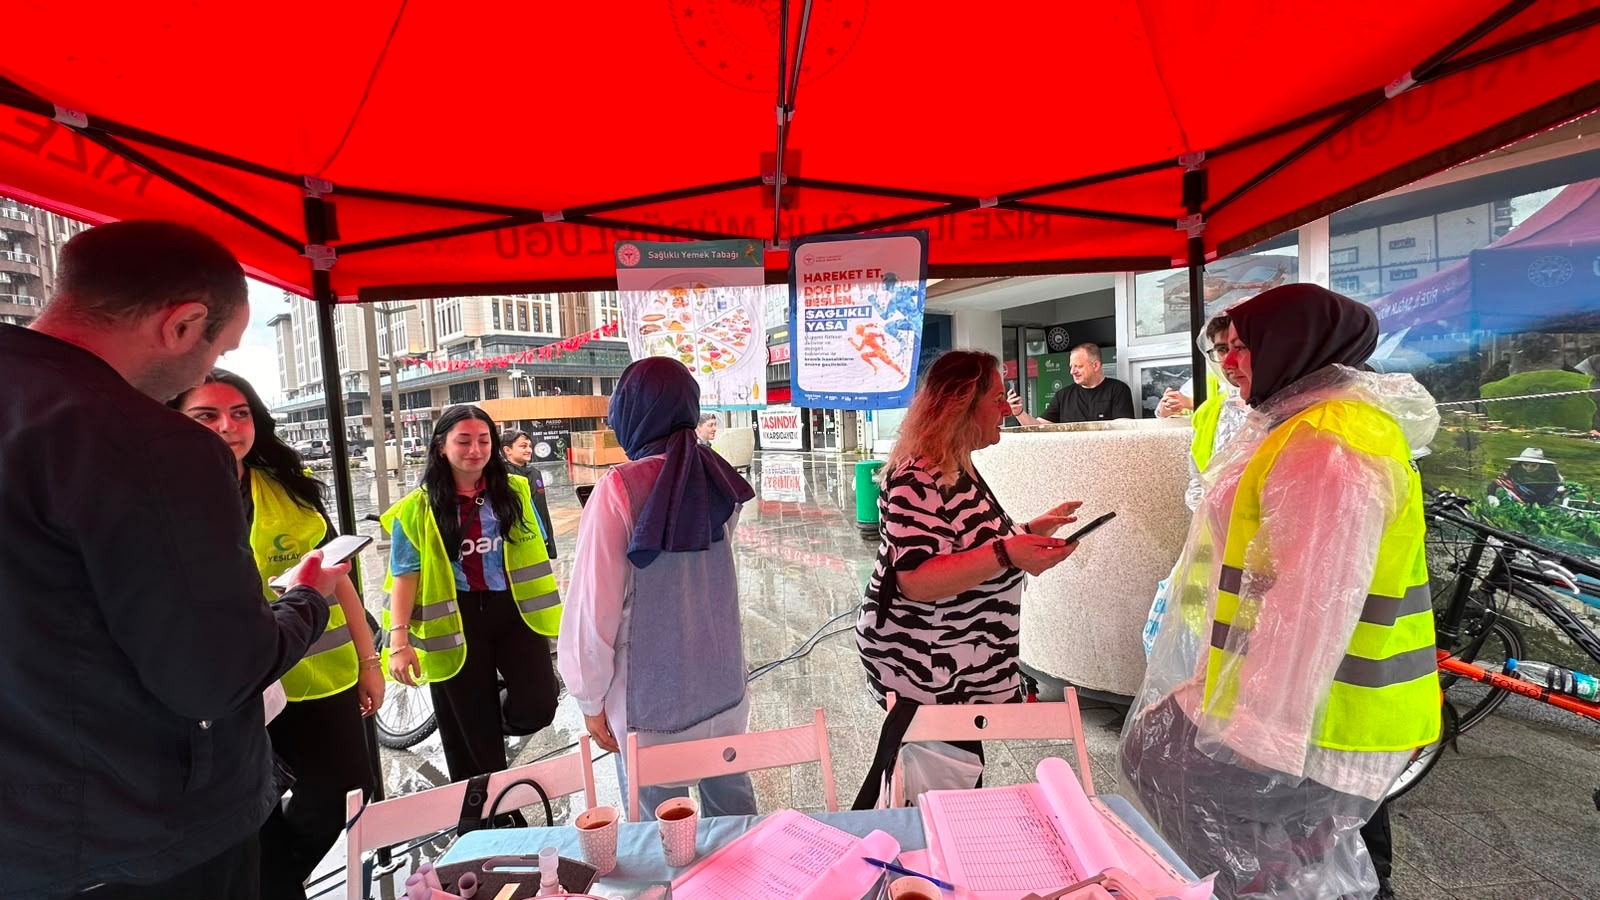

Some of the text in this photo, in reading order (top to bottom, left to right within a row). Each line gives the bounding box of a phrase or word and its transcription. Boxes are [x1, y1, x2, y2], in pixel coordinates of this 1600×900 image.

[648, 251, 739, 260] Sağlıklı Yemek Tabağı
[803, 268, 884, 283] HAREKET ET,
[804, 296, 855, 307] BESLEN,
